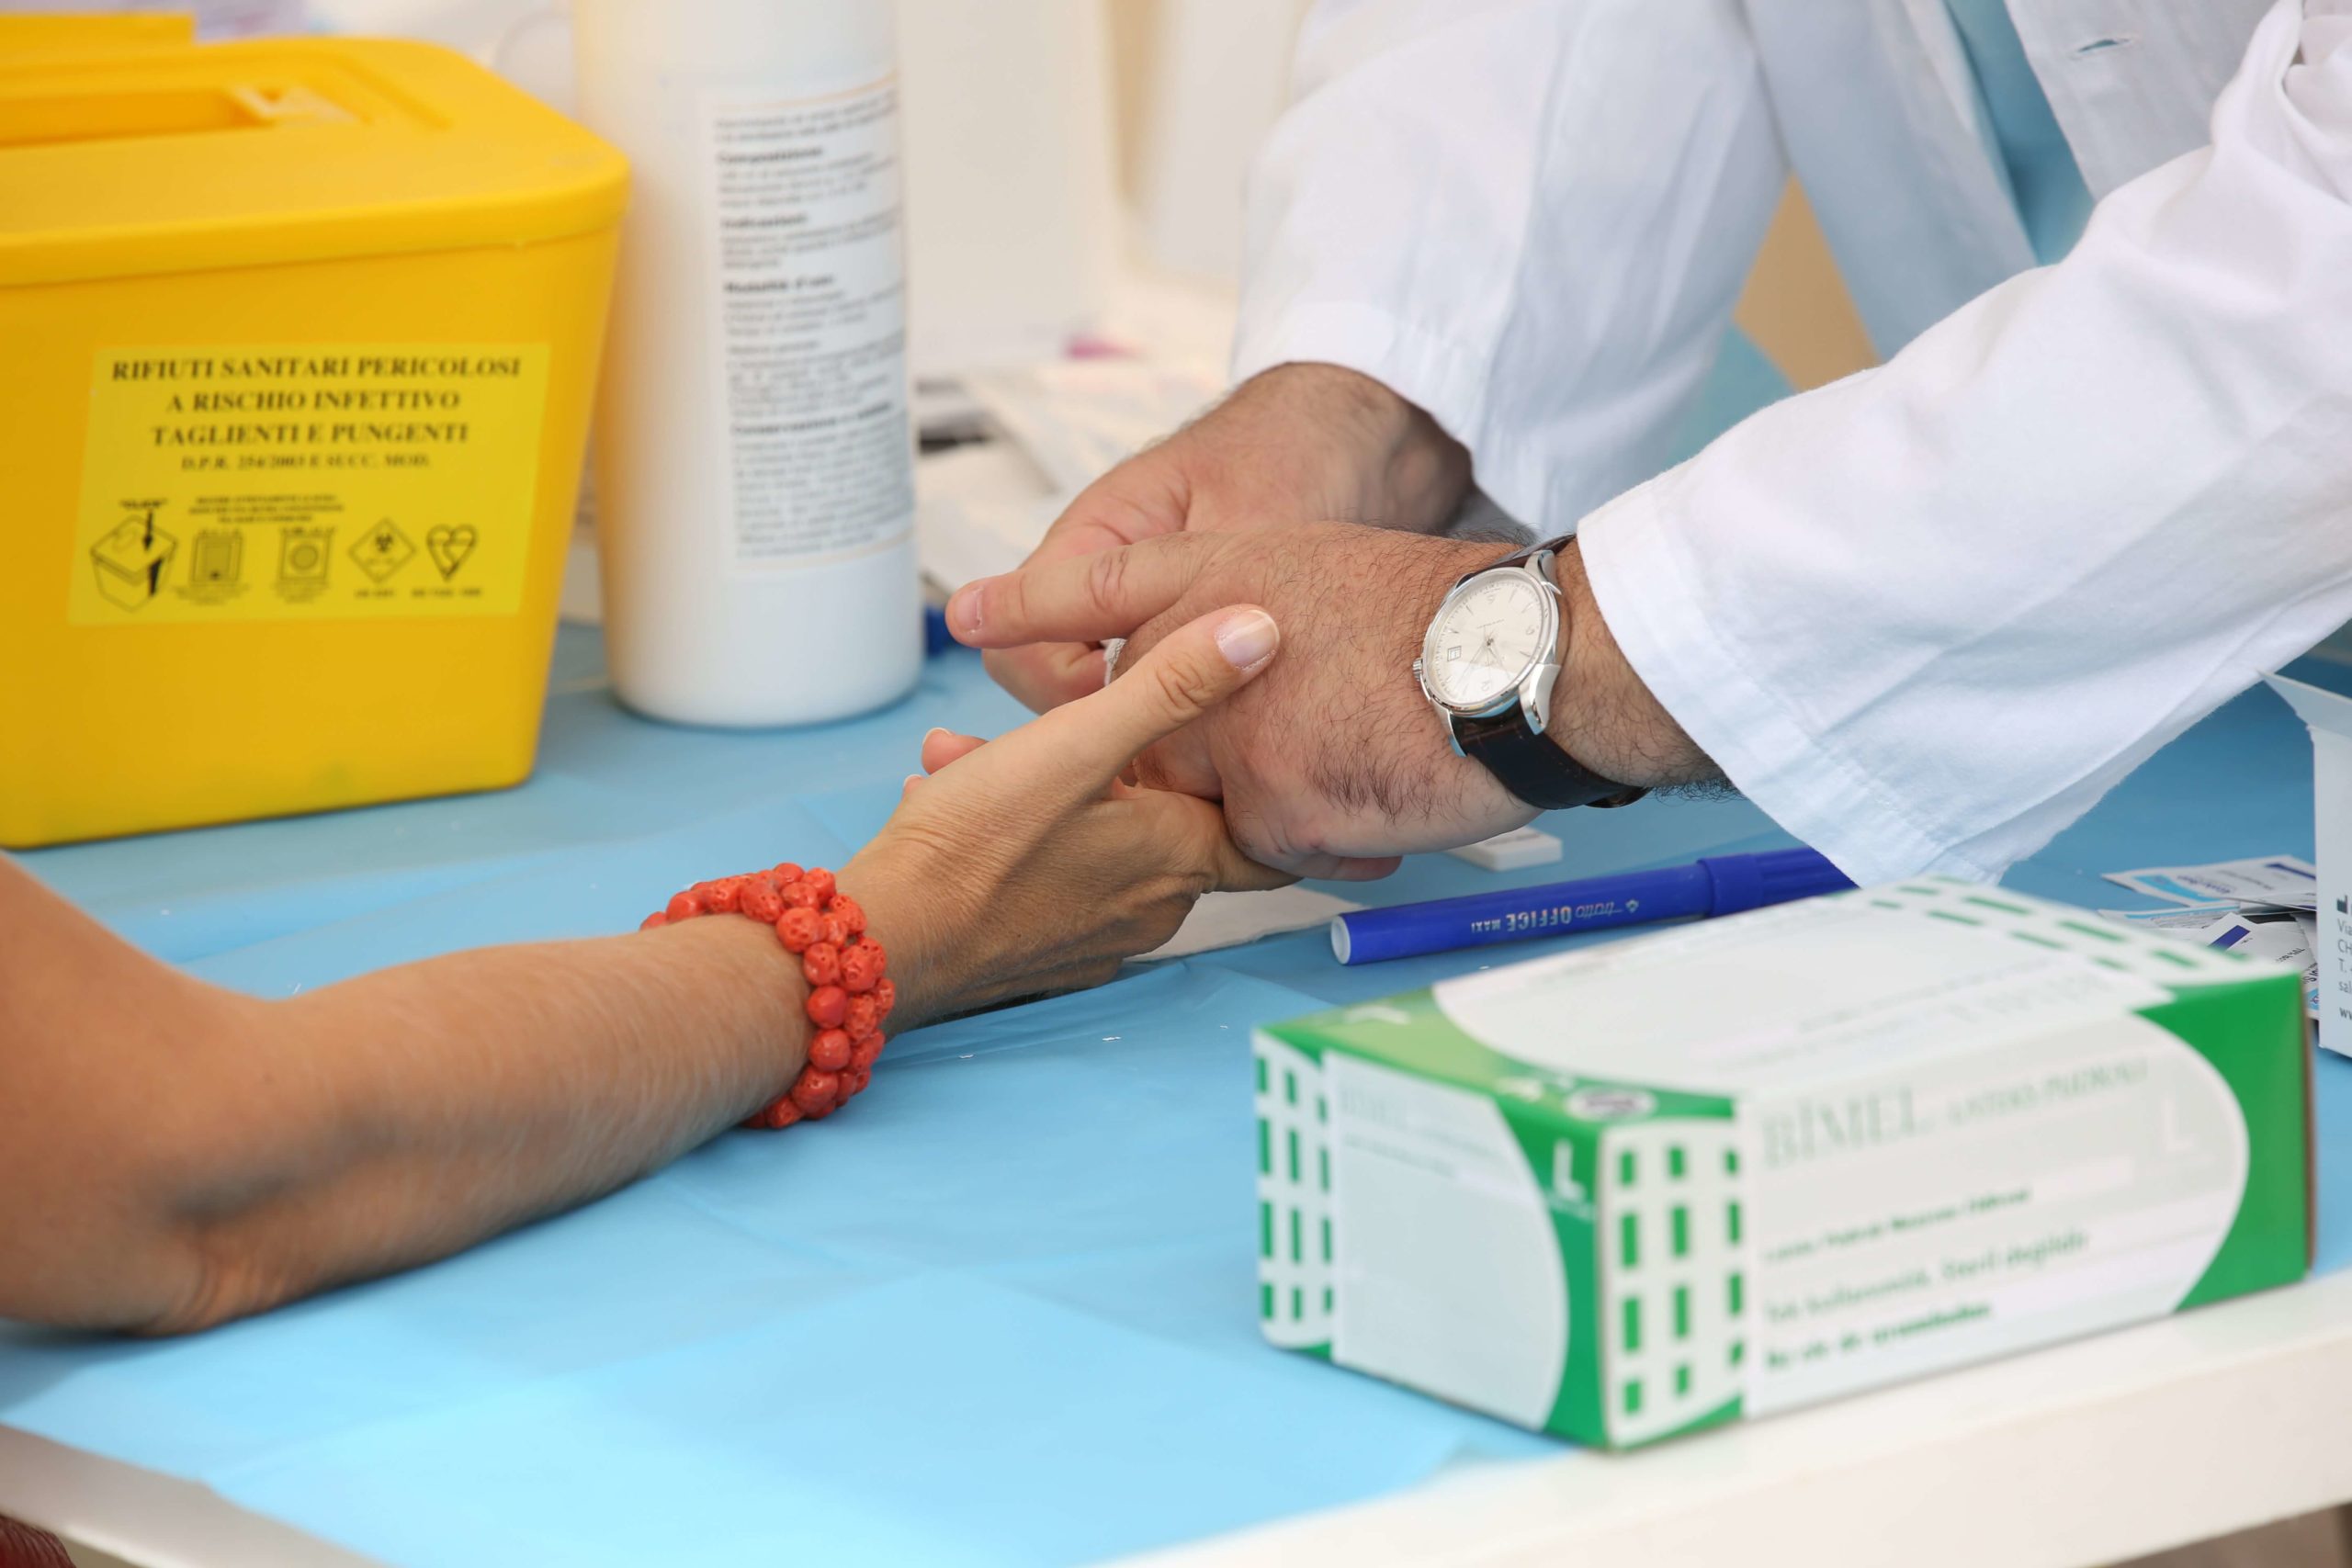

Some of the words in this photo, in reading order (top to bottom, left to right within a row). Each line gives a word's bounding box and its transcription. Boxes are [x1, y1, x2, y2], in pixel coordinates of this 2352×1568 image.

[111, 359, 213, 381] RIFIUTI
[220, 357, 349, 378] SANITARI
[357, 356, 521, 378] PERICOLOSI
[167, 395, 183, 412] A
[192, 391, 306, 412] RISCHIO
[313, 389, 460, 410] INFETTIVO
[152, 424, 299, 446] TAGLIENTI
[308, 423, 322, 444] E
[331, 423, 469, 444] PUNGENTI
[1471, 919, 1501, 933] MAXI
[1505, 905, 1573, 932] OFFICE
[1553, 1139, 1587, 1200] L
